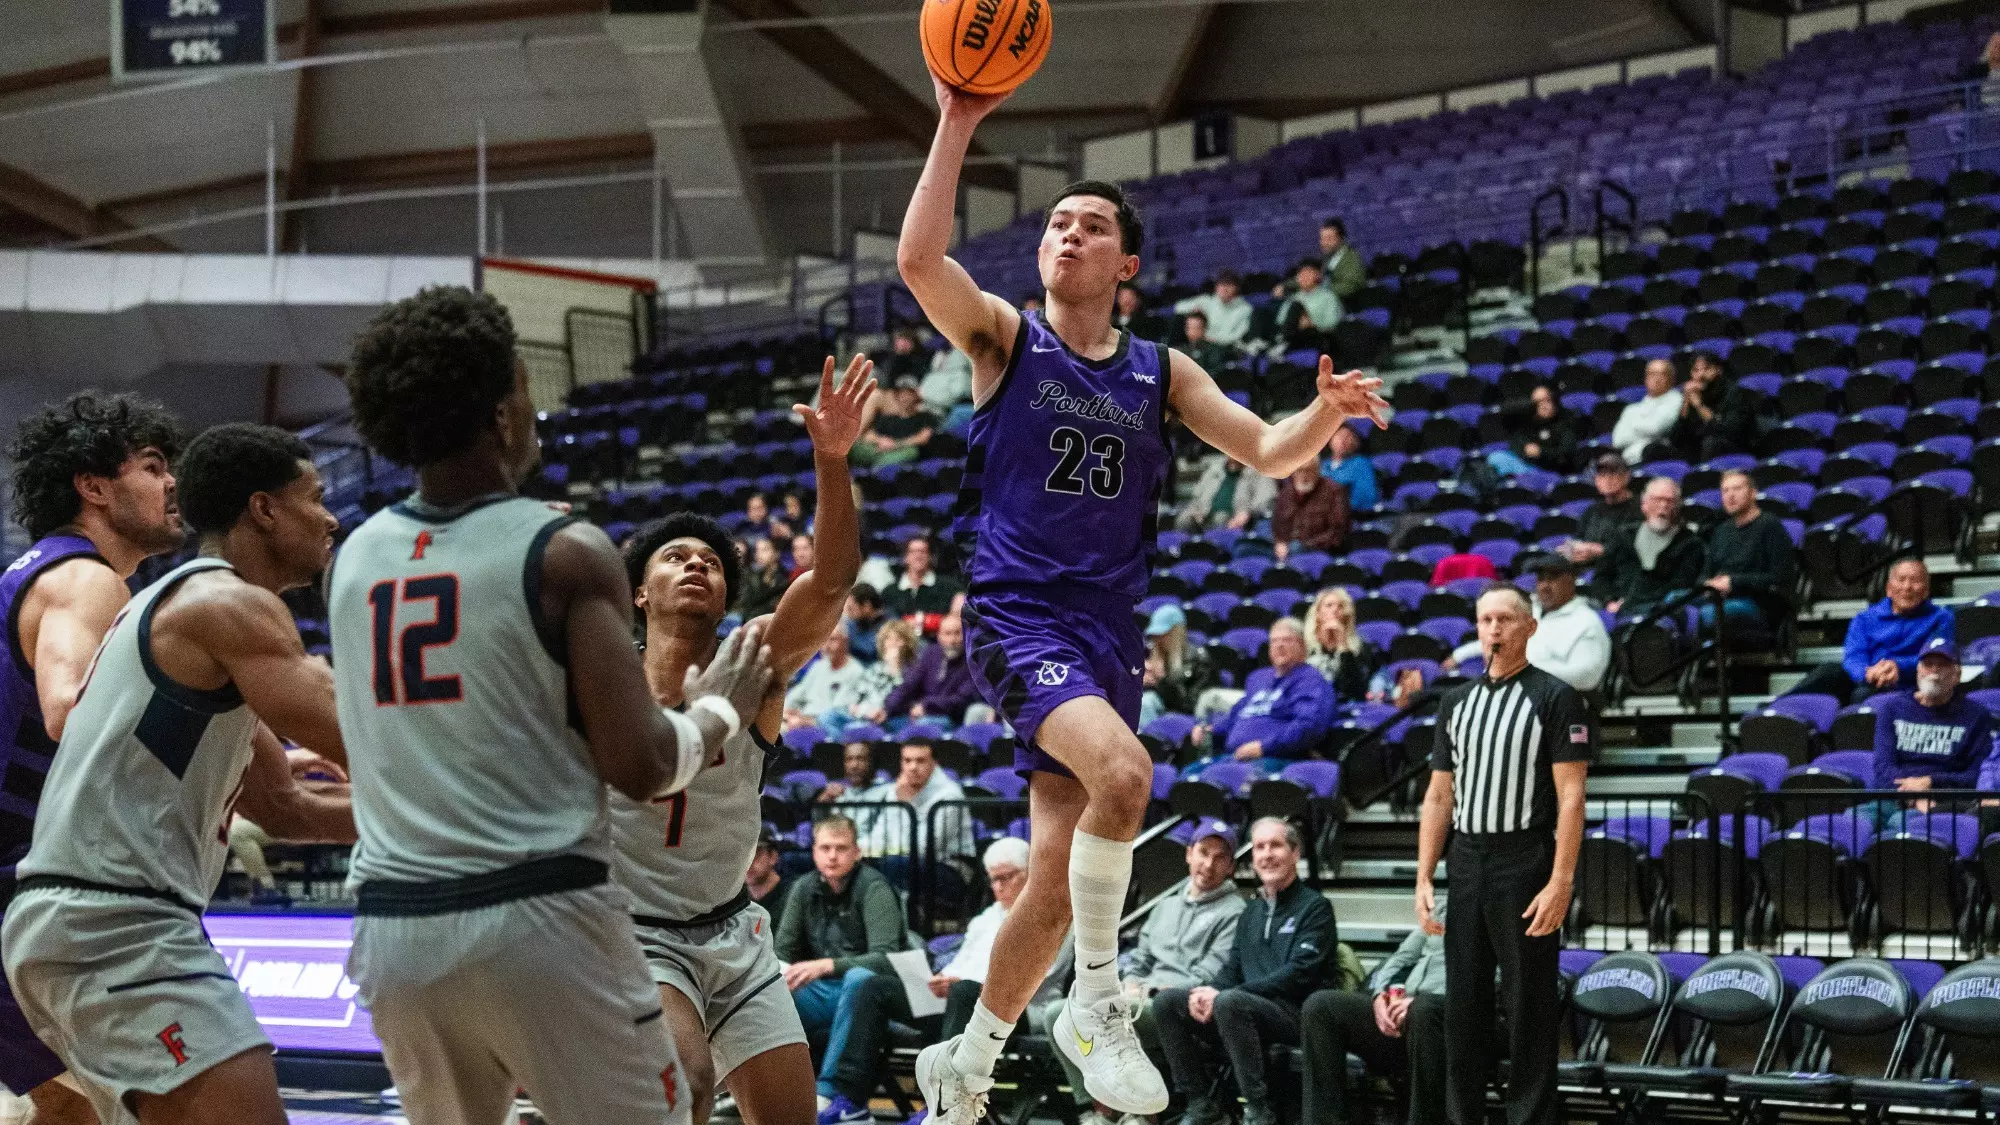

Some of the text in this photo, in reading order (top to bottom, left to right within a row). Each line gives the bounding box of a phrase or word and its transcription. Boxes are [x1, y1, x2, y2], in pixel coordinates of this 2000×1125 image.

[962, 0, 1001, 50] Wil
[1008, 0, 1041, 60] NCAA
[1030, 379, 1149, 430] Portland
[1045, 426, 1125, 499] 23
[367, 572, 464, 707] 12
[1575, 967, 1656, 1000] PORTLAND
[1685, 968, 1769, 1000] PORTLAND
[1804, 975, 1897, 1008] PORTLAND
[156, 1021, 190, 1068] F
